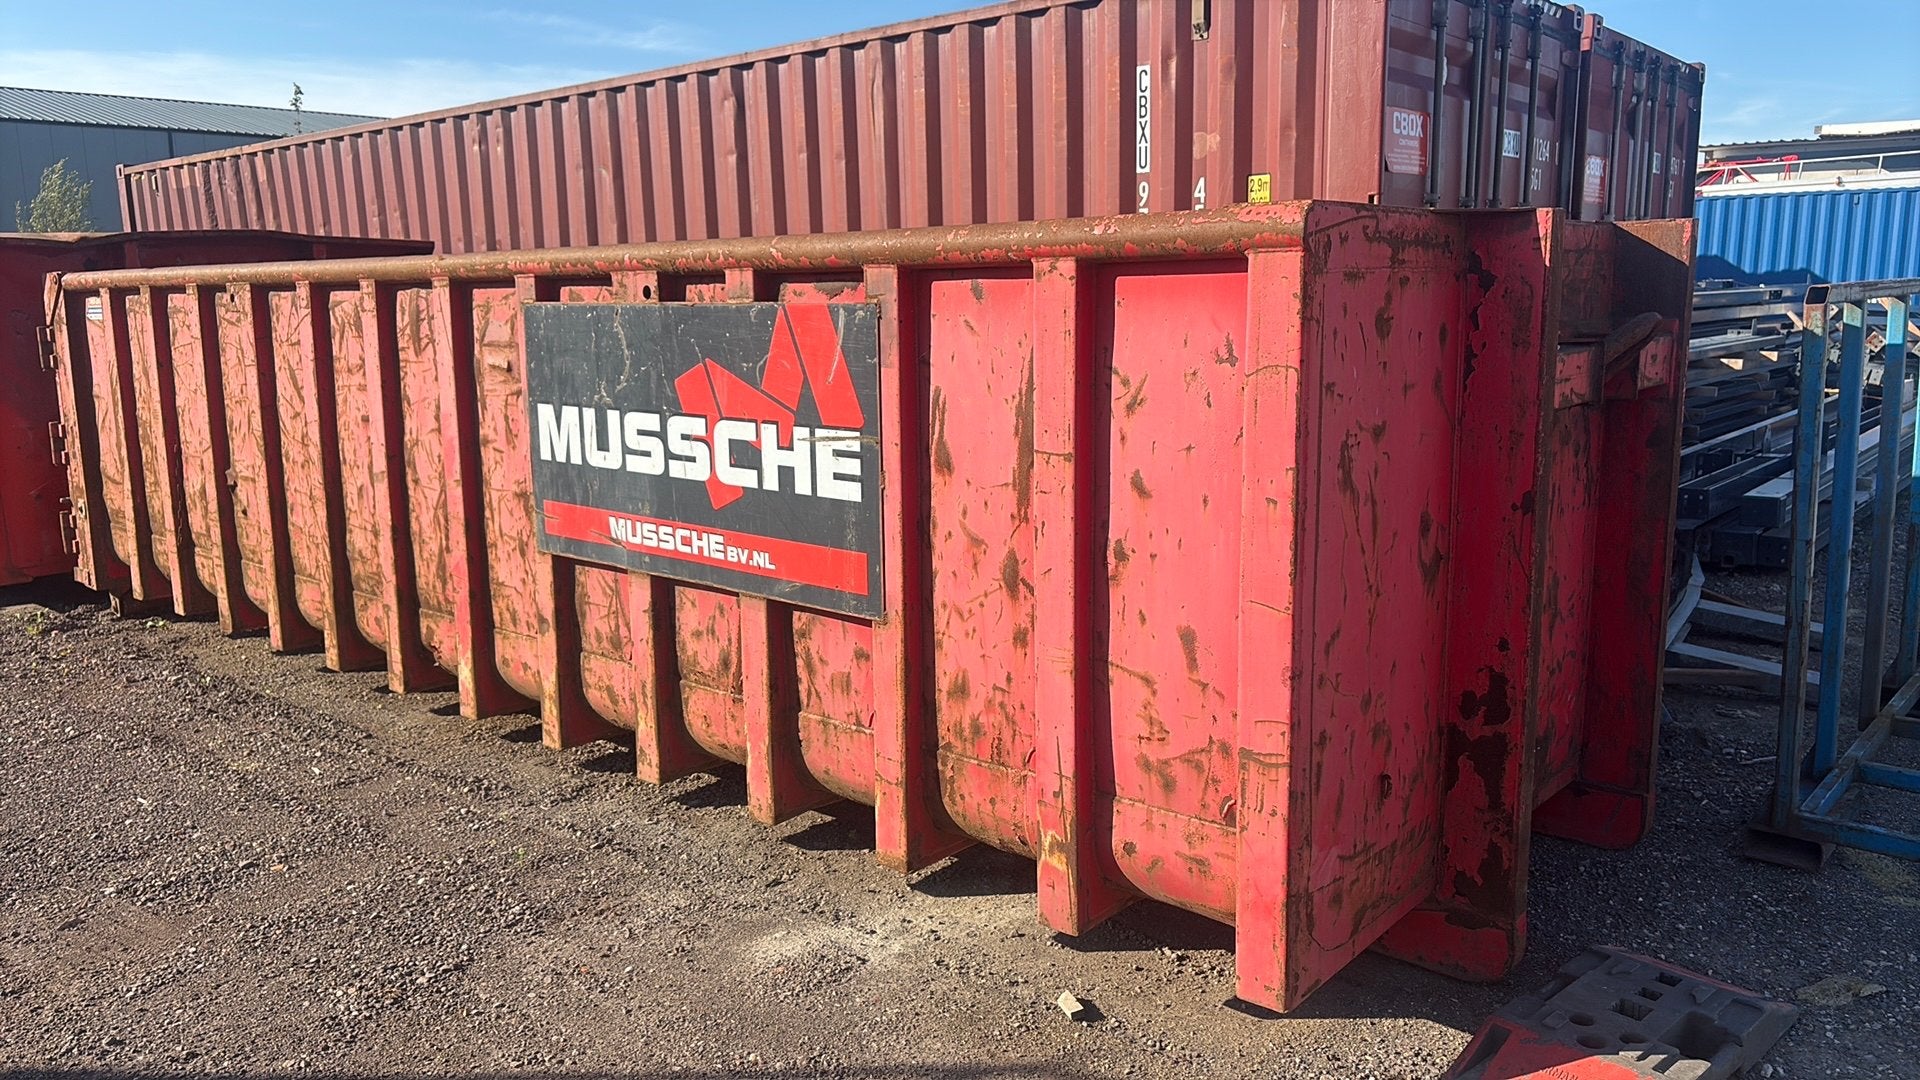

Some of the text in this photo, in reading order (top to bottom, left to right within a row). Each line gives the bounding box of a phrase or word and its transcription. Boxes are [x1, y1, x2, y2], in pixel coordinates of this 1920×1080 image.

[1137, 69, 1149, 214] CBXU 9
[1393, 111, 1424, 138] CBOX
[1193, 176, 1206, 211] 4
[536, 402, 863, 503] MUSSCHE
[608, 515, 726, 561] MUSSCHE
